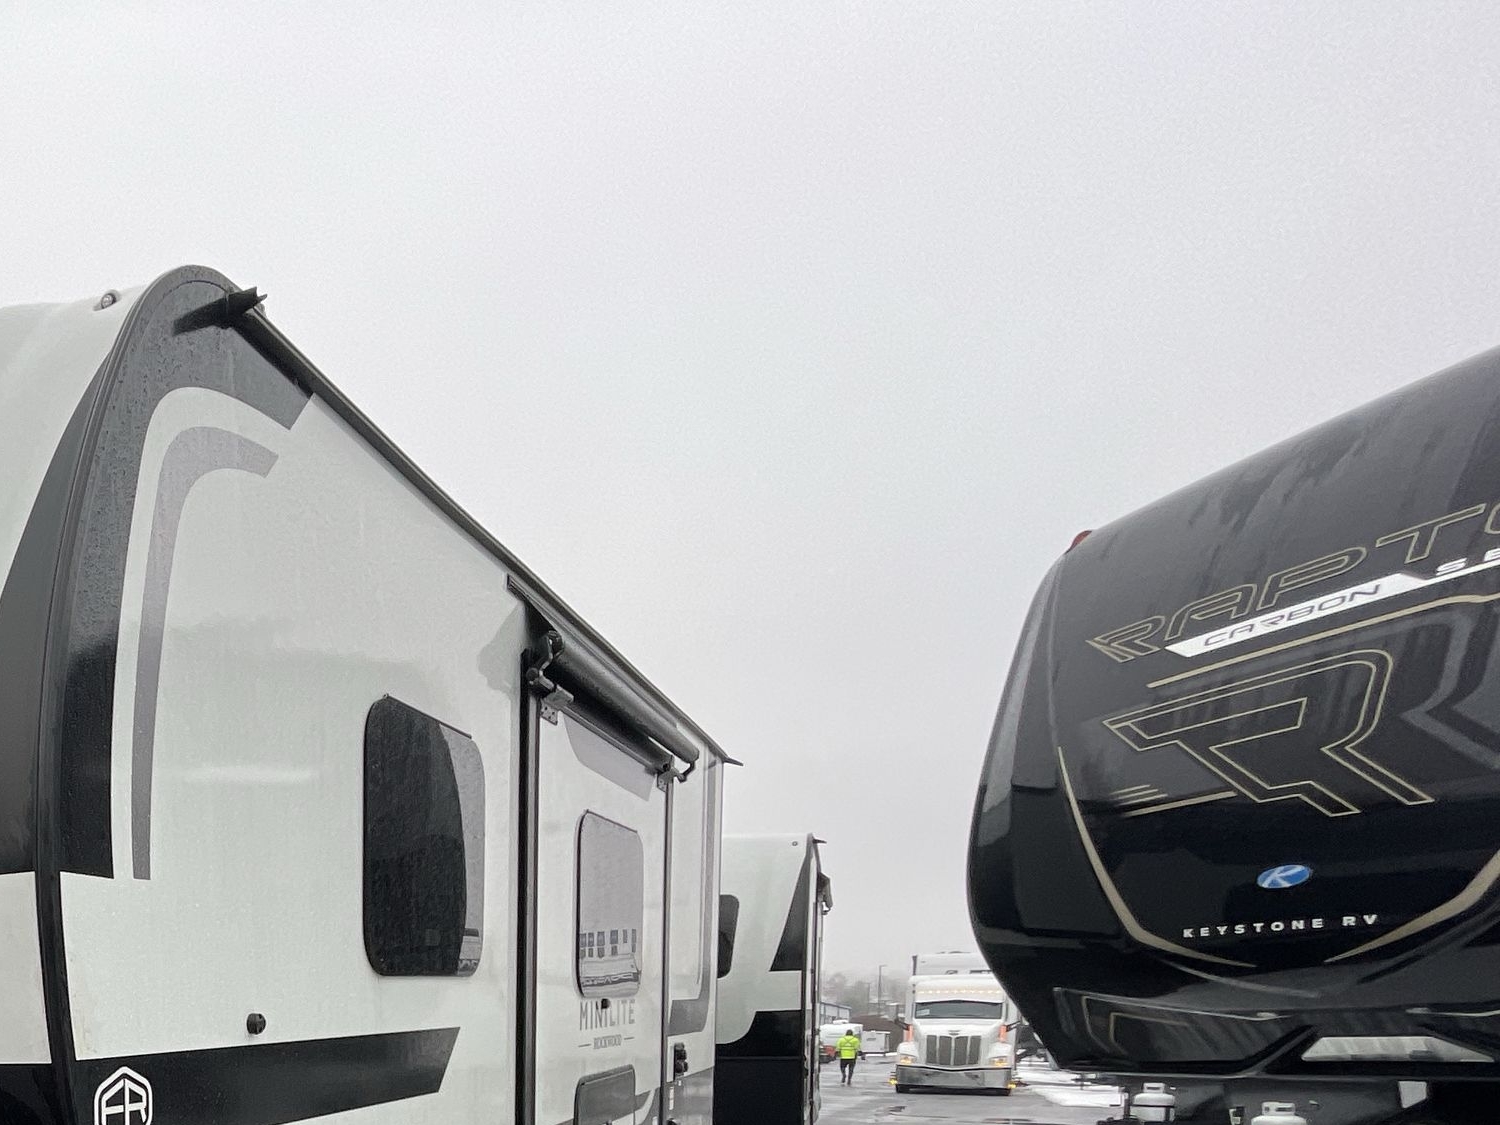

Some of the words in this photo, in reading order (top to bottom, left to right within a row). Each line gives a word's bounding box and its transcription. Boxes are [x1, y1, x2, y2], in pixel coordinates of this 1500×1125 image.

[1086, 502, 1500, 663] RAPT
[1203, 584, 1380, 646] CARBON
[1182, 917, 1325, 938] KEYSTONE
[1342, 914, 1378, 926] RV
[579, 999, 636, 1031] MINILITE
